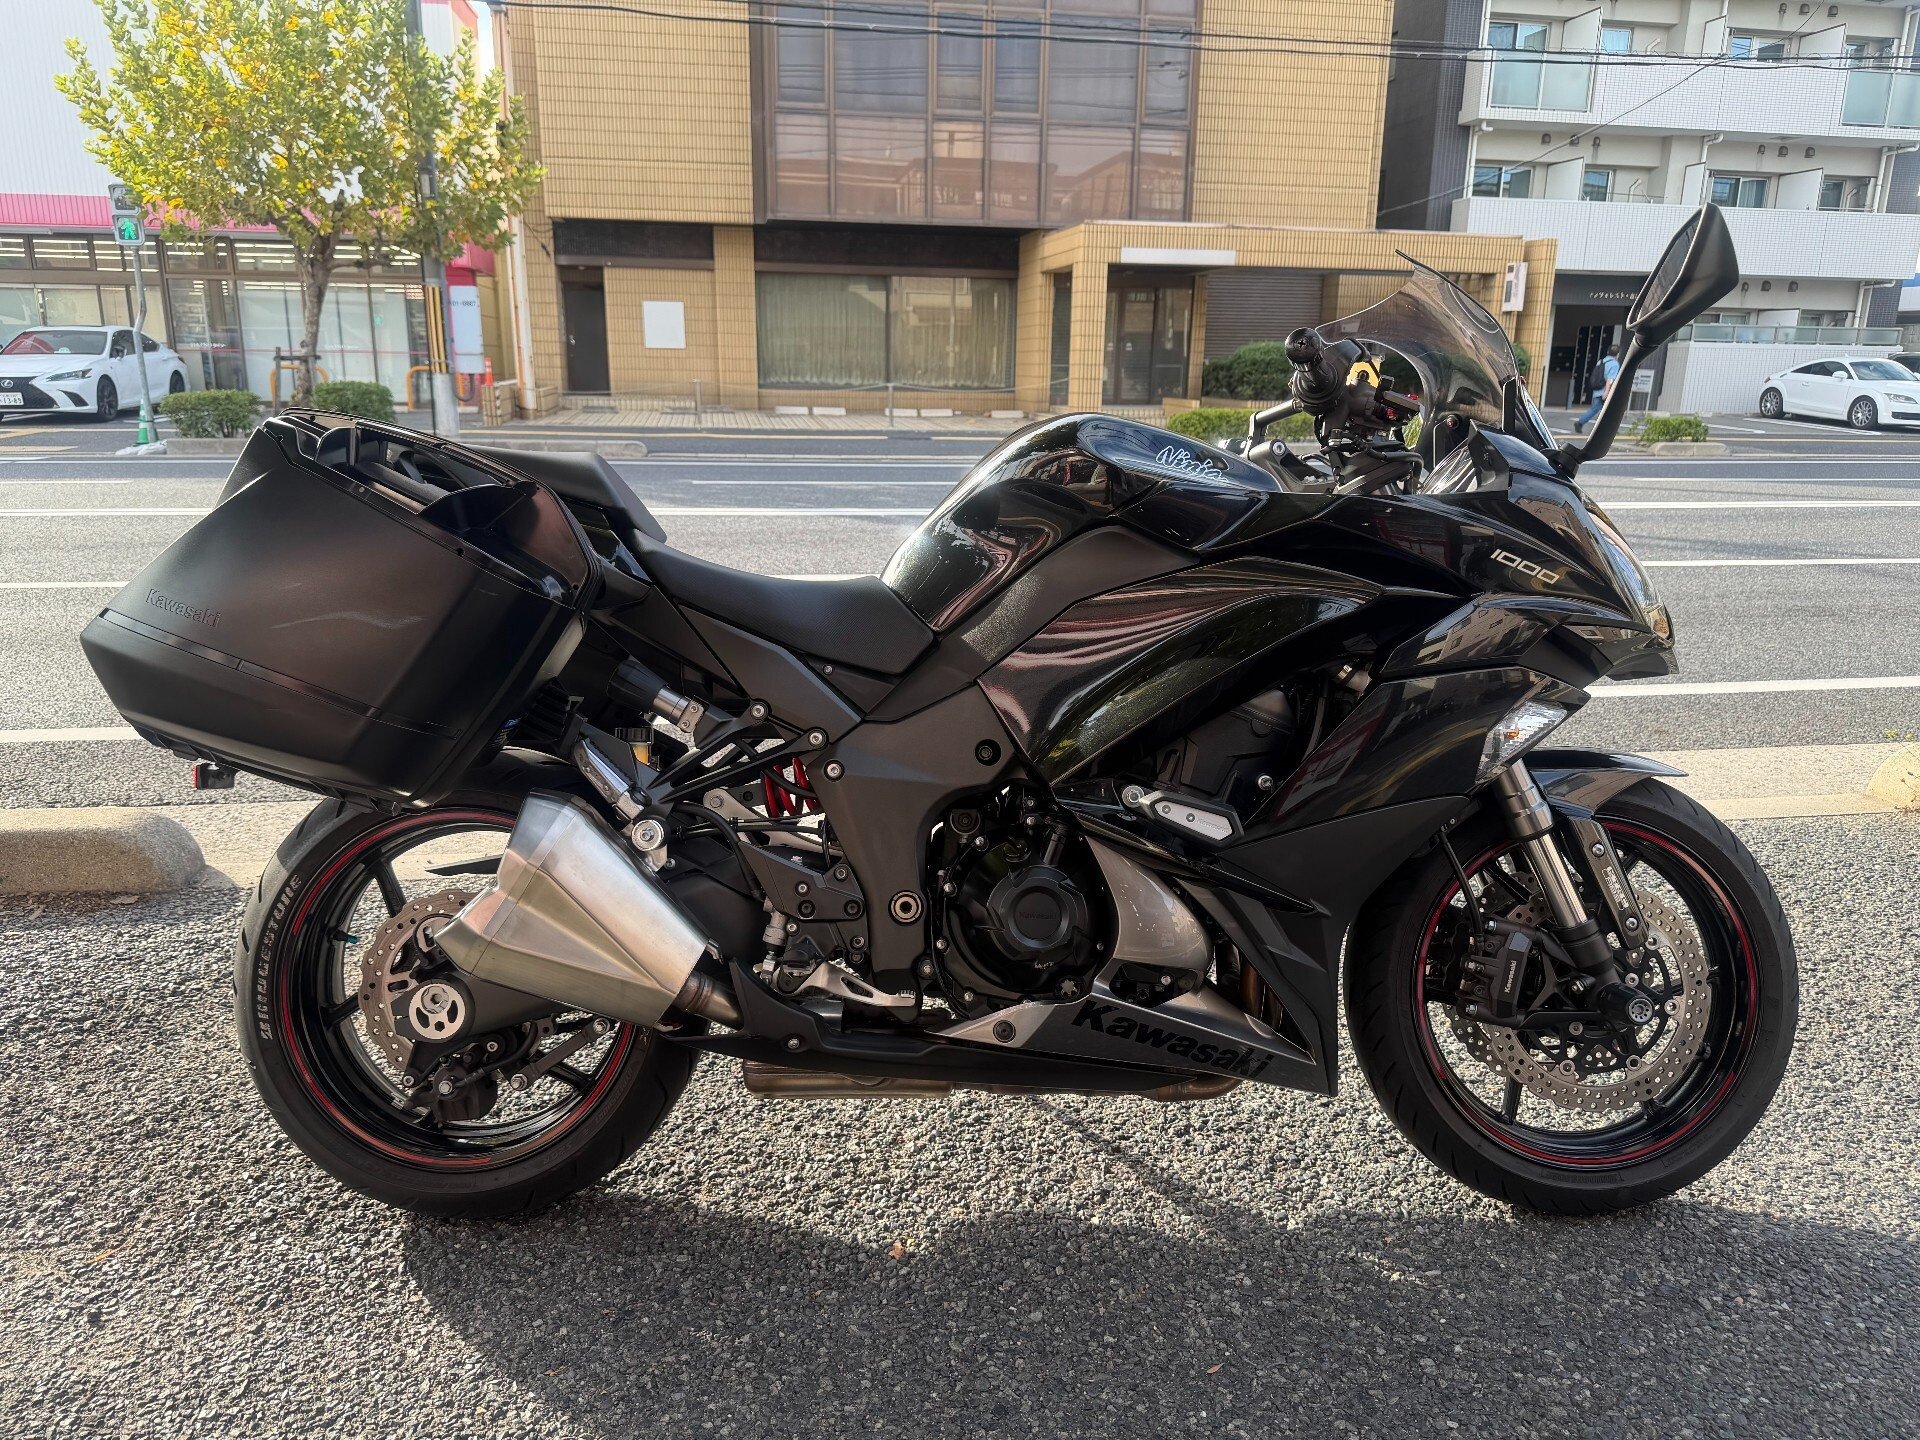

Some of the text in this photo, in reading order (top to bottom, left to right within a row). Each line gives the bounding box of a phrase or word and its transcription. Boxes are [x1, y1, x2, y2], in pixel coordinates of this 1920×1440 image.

[1156, 445, 1228, 482] Ninja
[1490, 548, 1560, 585] 1000
[146, 588, 221, 628] Kawasaki
[1504, 960, 1517, 993] Kawasaki
[1071, 1000, 1275, 1078] Kawasaki
